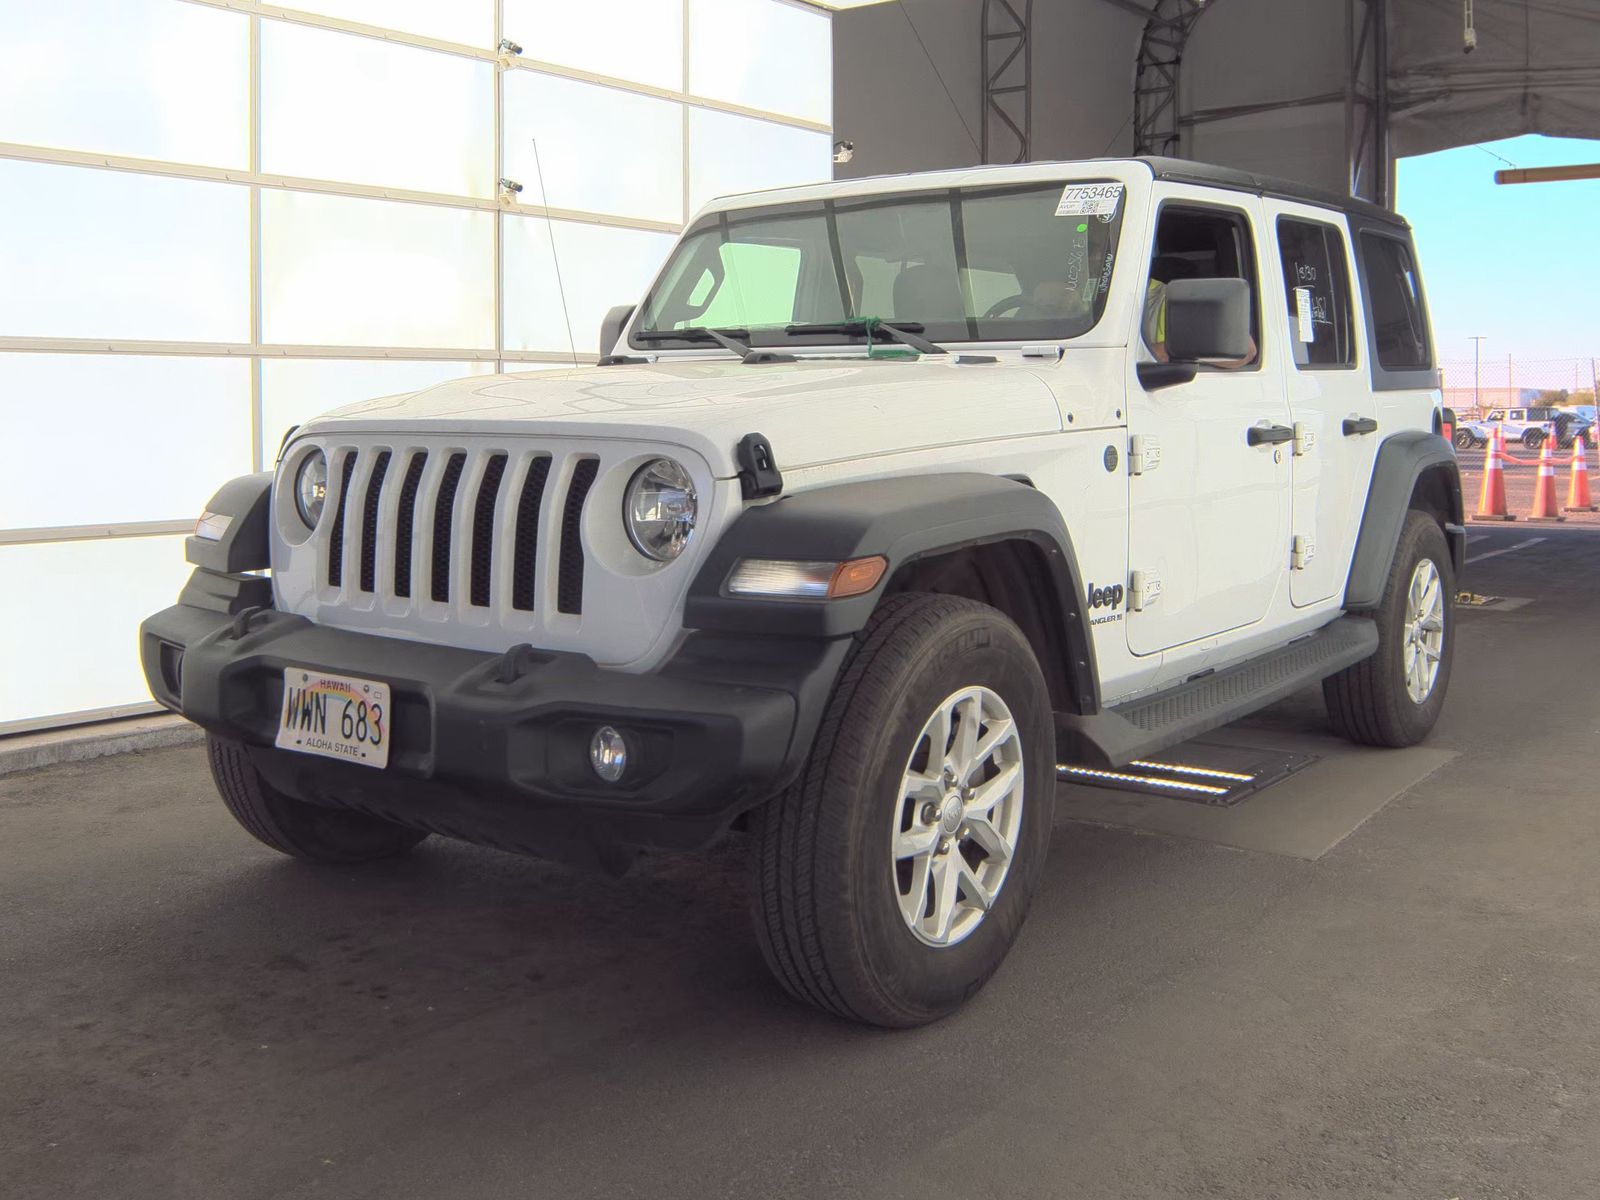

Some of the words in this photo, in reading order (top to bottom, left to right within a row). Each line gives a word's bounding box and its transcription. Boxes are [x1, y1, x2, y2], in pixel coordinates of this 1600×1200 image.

[1066, 186, 1122, 200] 7753465
[1088, 583, 1123, 610] Jeep
[1090, 615, 1116, 625] ANGLER
[320, 680, 351, 692] HAWAII
[286, 687, 327, 735] WWN
[342, 699, 382, 745] 683
[306, 738, 333, 751] ALOHA
[335, 742, 358, 756] STATE
